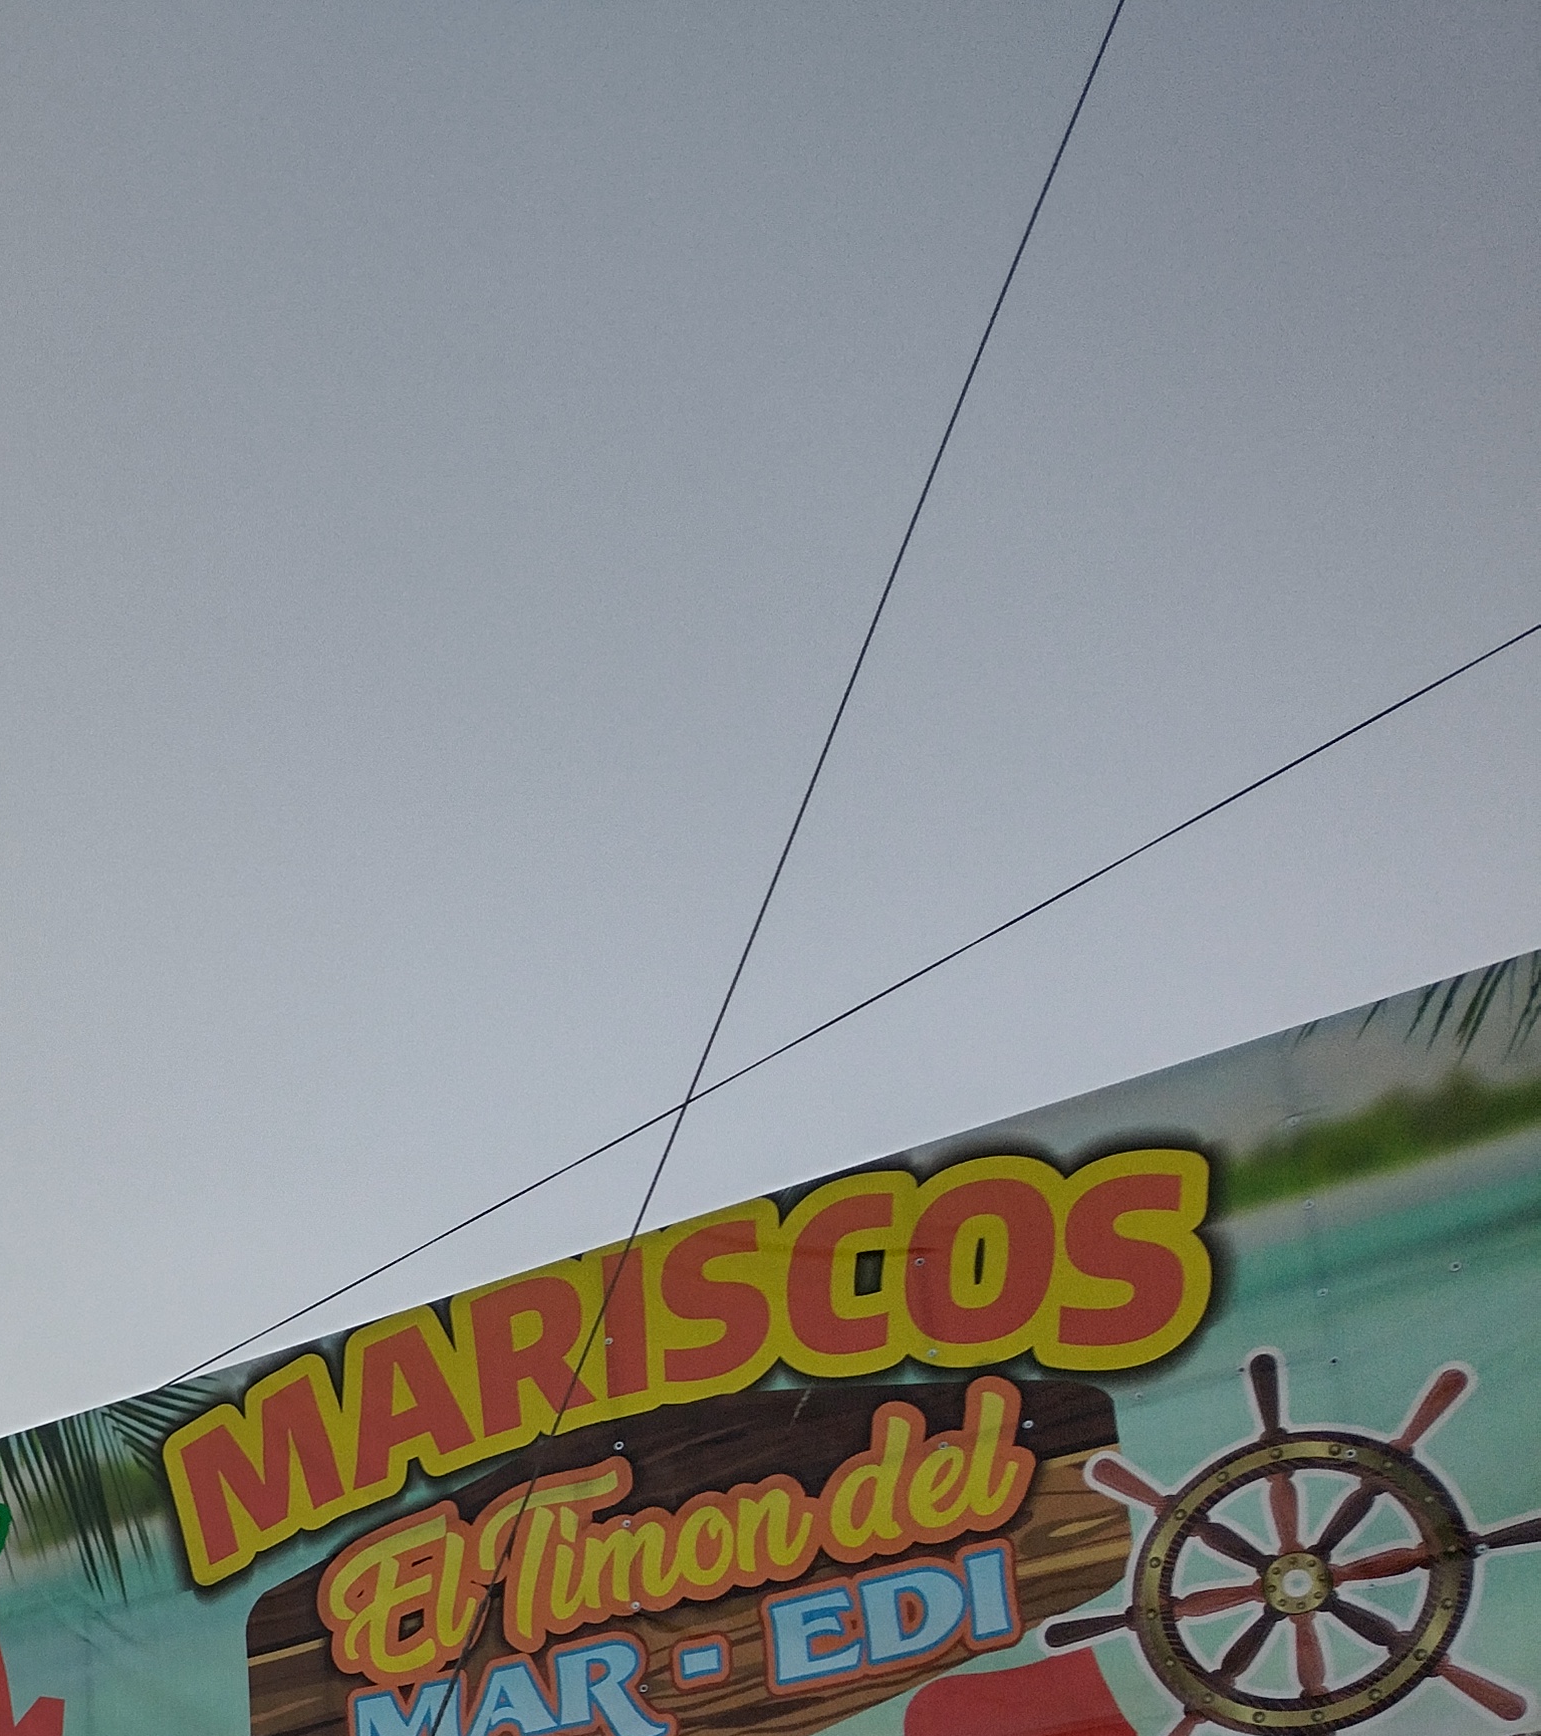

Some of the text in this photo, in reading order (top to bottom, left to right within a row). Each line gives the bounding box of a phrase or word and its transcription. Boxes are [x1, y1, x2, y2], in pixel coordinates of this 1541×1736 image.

[175, 1168, 1188, 1568] MARISCOS
[326, 1388, 1020, 1674] El Timon del
[767, 1546, 1015, 1686] EDI
